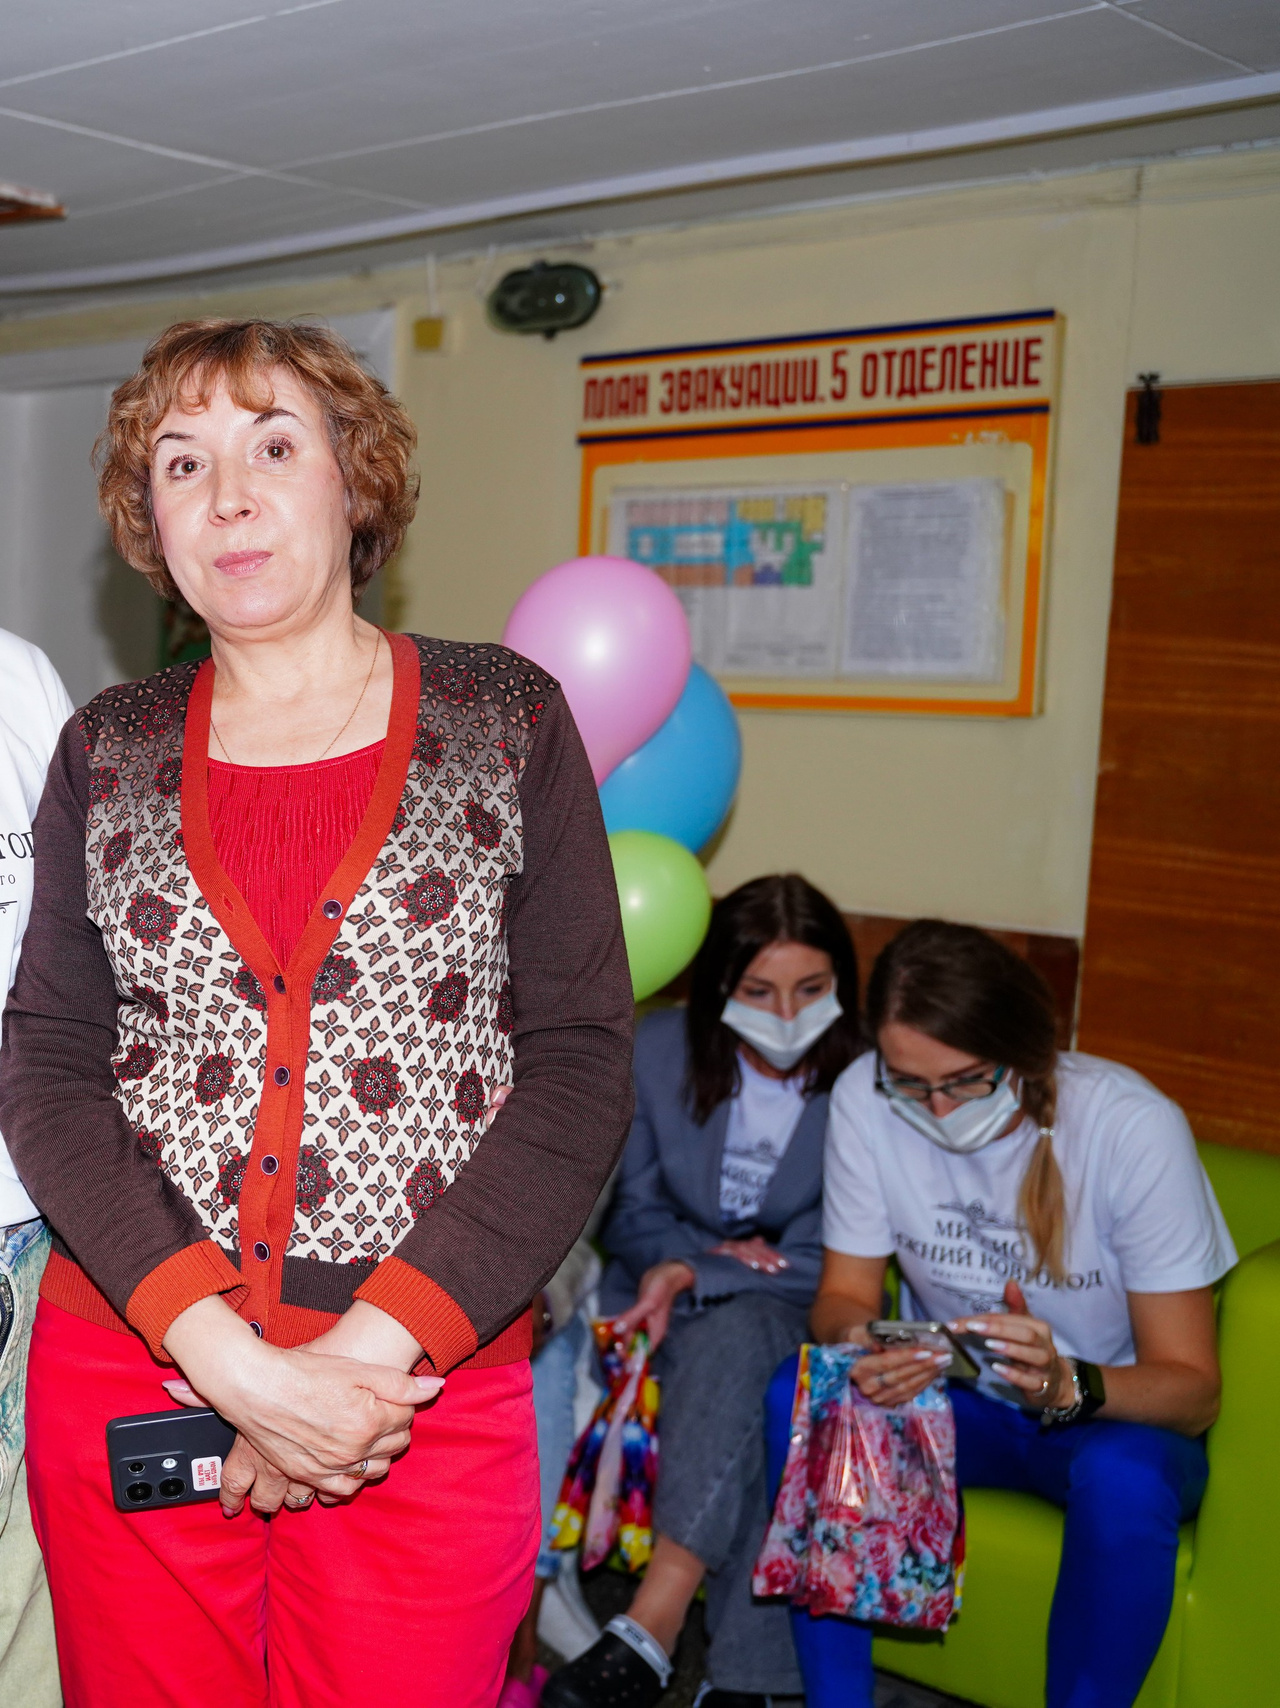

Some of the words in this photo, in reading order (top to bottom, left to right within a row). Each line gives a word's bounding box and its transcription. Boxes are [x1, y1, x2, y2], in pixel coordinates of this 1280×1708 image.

[583, 373, 649, 421] ПЛАН
[831, 349, 849, 401] 5
[861, 337, 1042, 399] ОТДЕЛЕНИЕ
